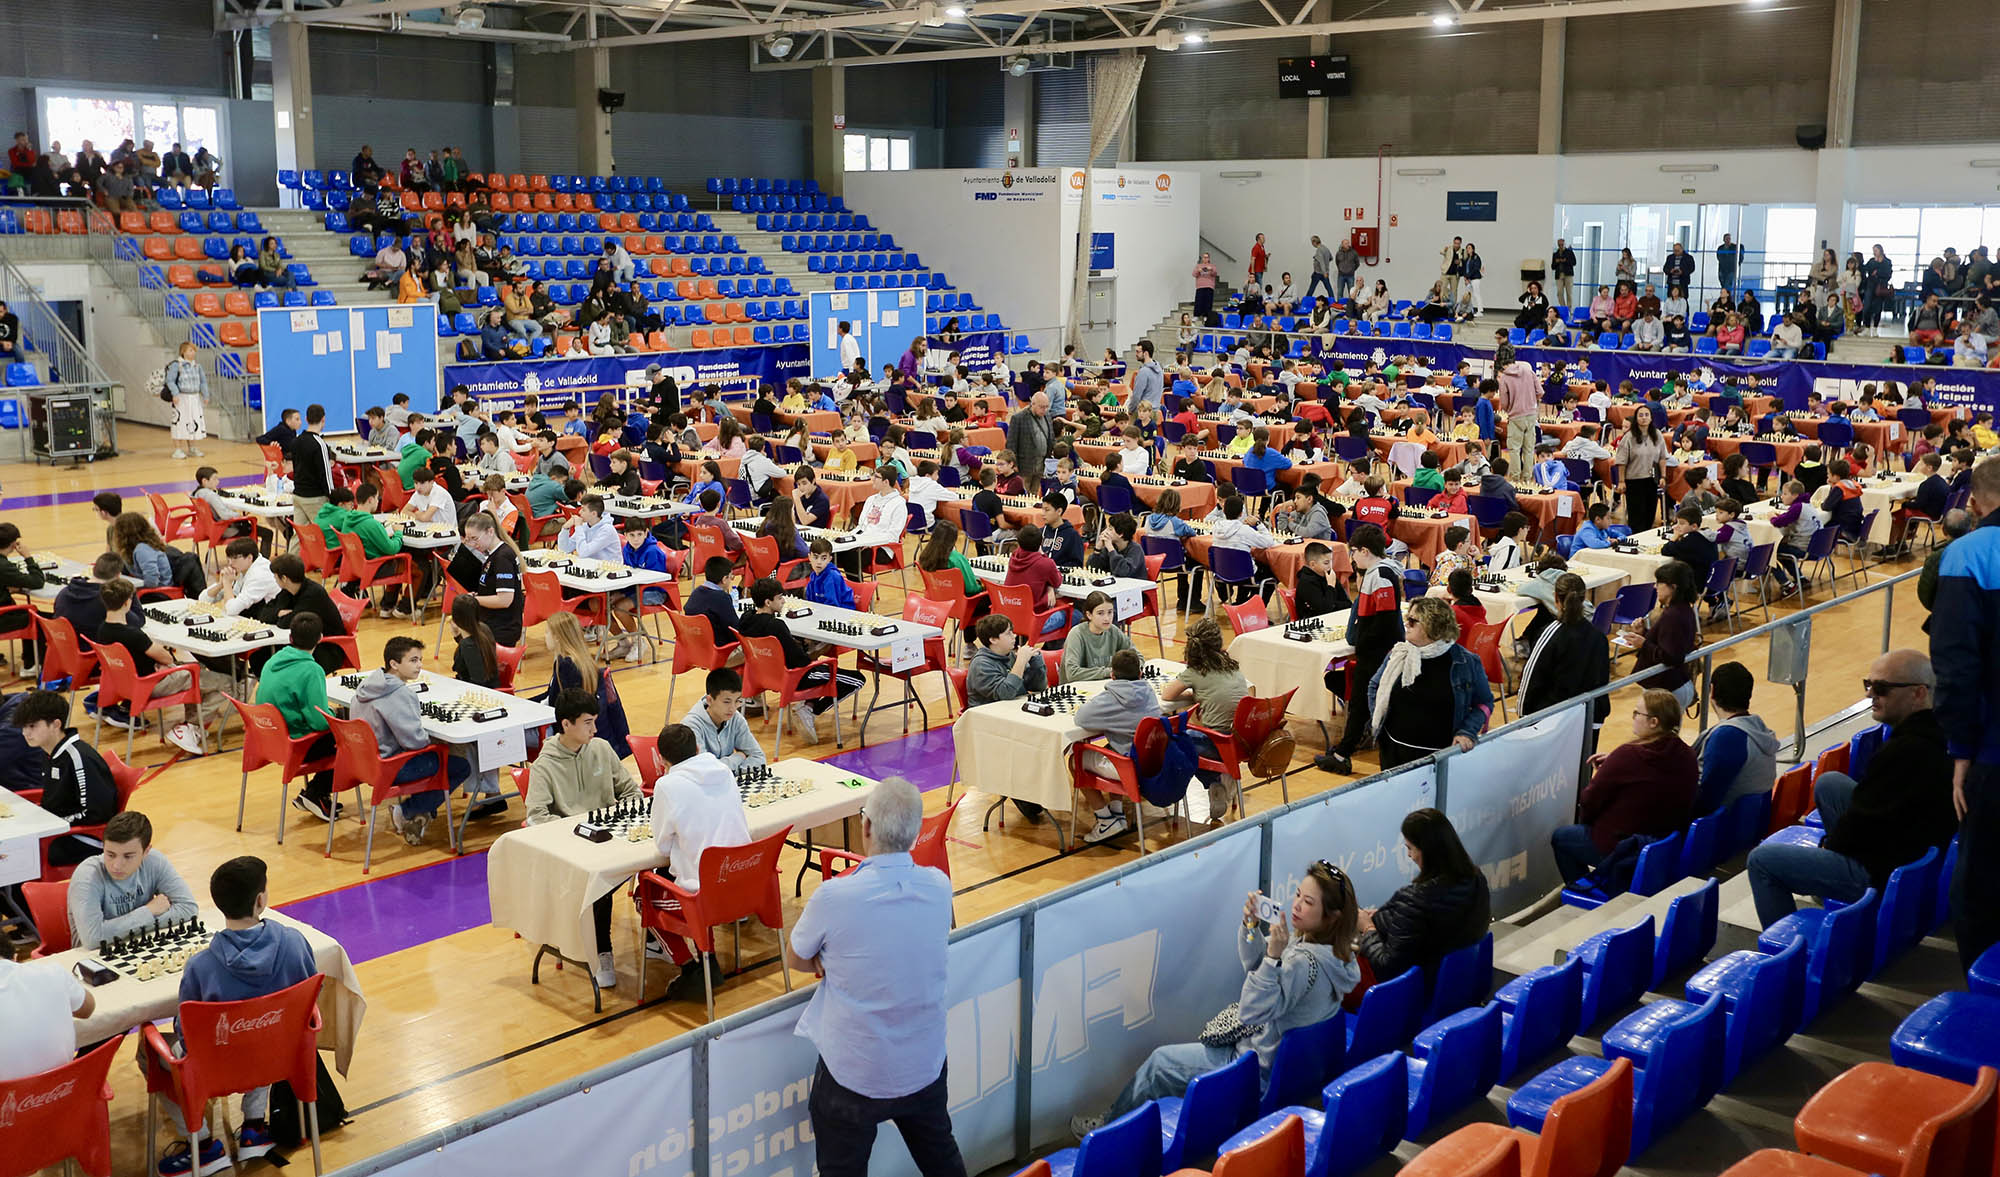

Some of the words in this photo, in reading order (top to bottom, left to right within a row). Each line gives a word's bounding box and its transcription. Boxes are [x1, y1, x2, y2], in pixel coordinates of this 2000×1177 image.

[963, 176, 1000, 184] Ayuntamiento
[975, 192, 997, 201] FMD
[1319, 351, 1368, 361] Ayuntamiento
[698, 363, 739, 371] Fundación
[544, 378, 555, 387] de
[558, 374, 598, 386] Valladolid
[1935, 384, 1975, 393] dación
[230, 1008, 285, 1034] Coca-Cola
[16, 1079, 77, 1112] Coca-Cola
